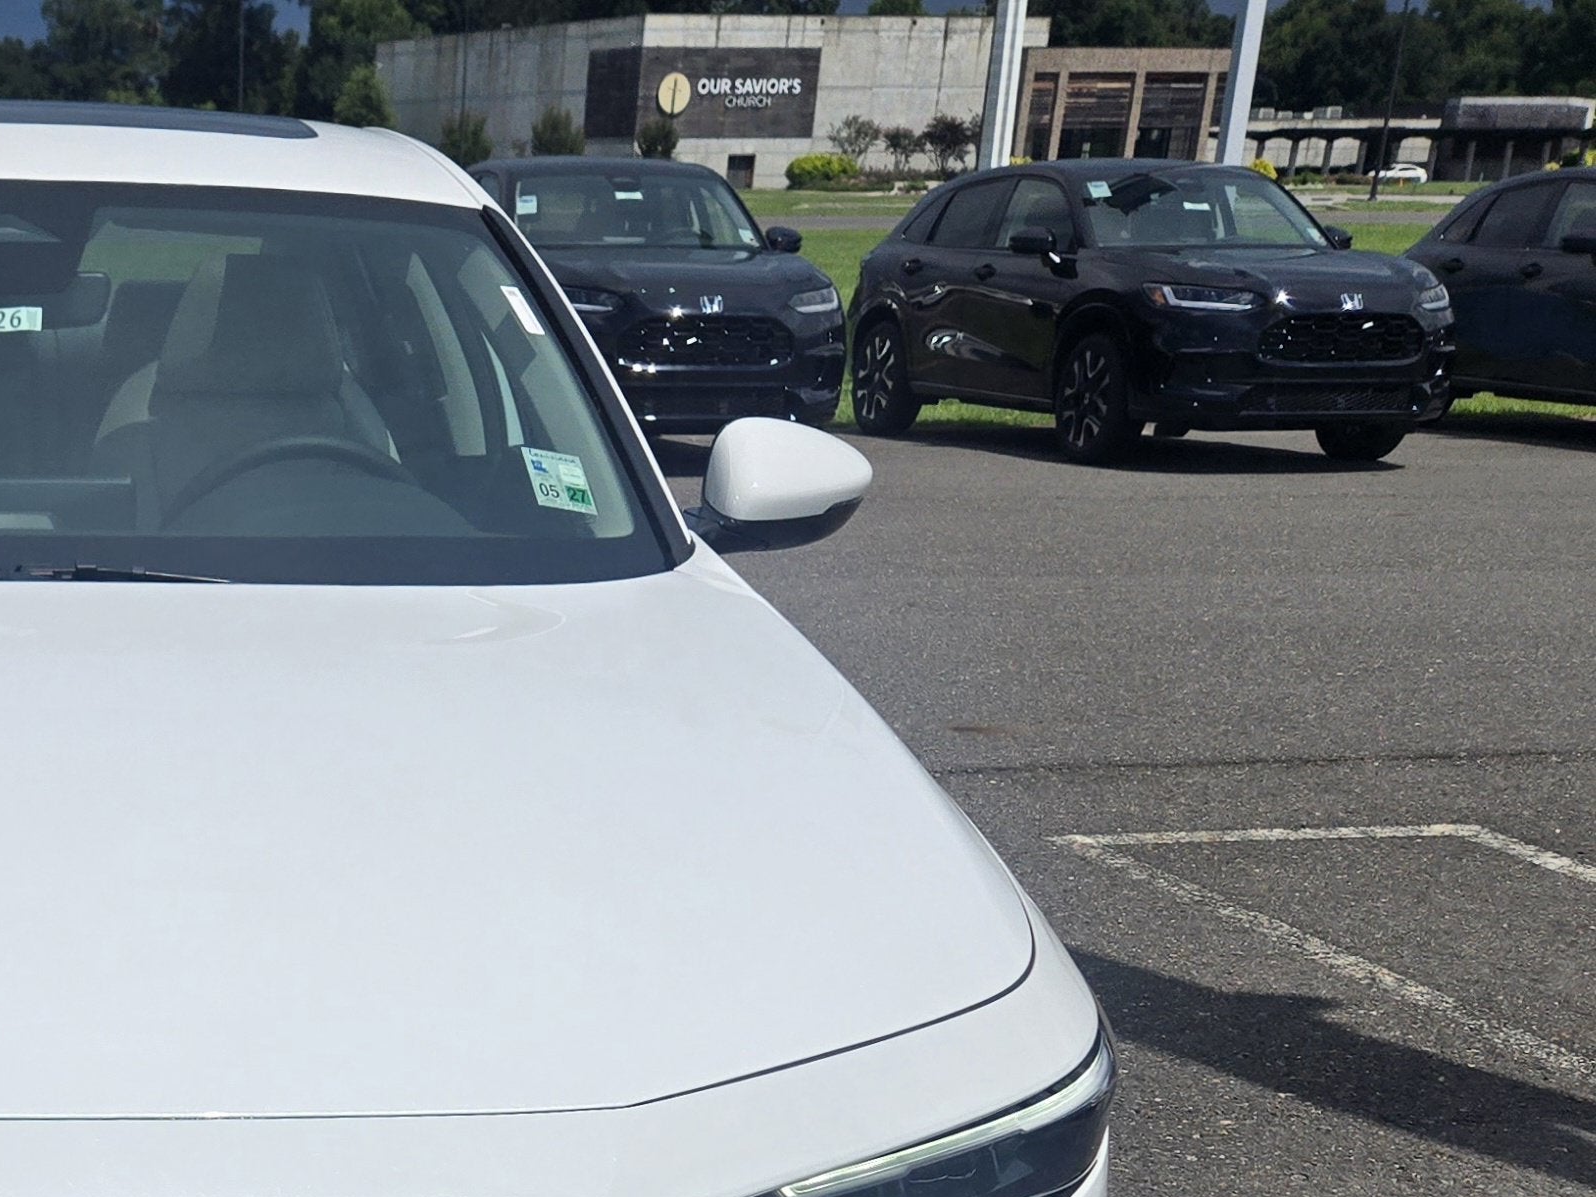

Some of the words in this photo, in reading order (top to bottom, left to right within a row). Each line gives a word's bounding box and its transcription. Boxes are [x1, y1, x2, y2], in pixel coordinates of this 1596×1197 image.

[697, 77, 732, 95] OUR
[734, 77, 802, 95] SAVIOR'S
[724, 95, 771, 107] CHURCH
[539, 482, 560, 499] 05
[566, 486, 586, 503] 27
